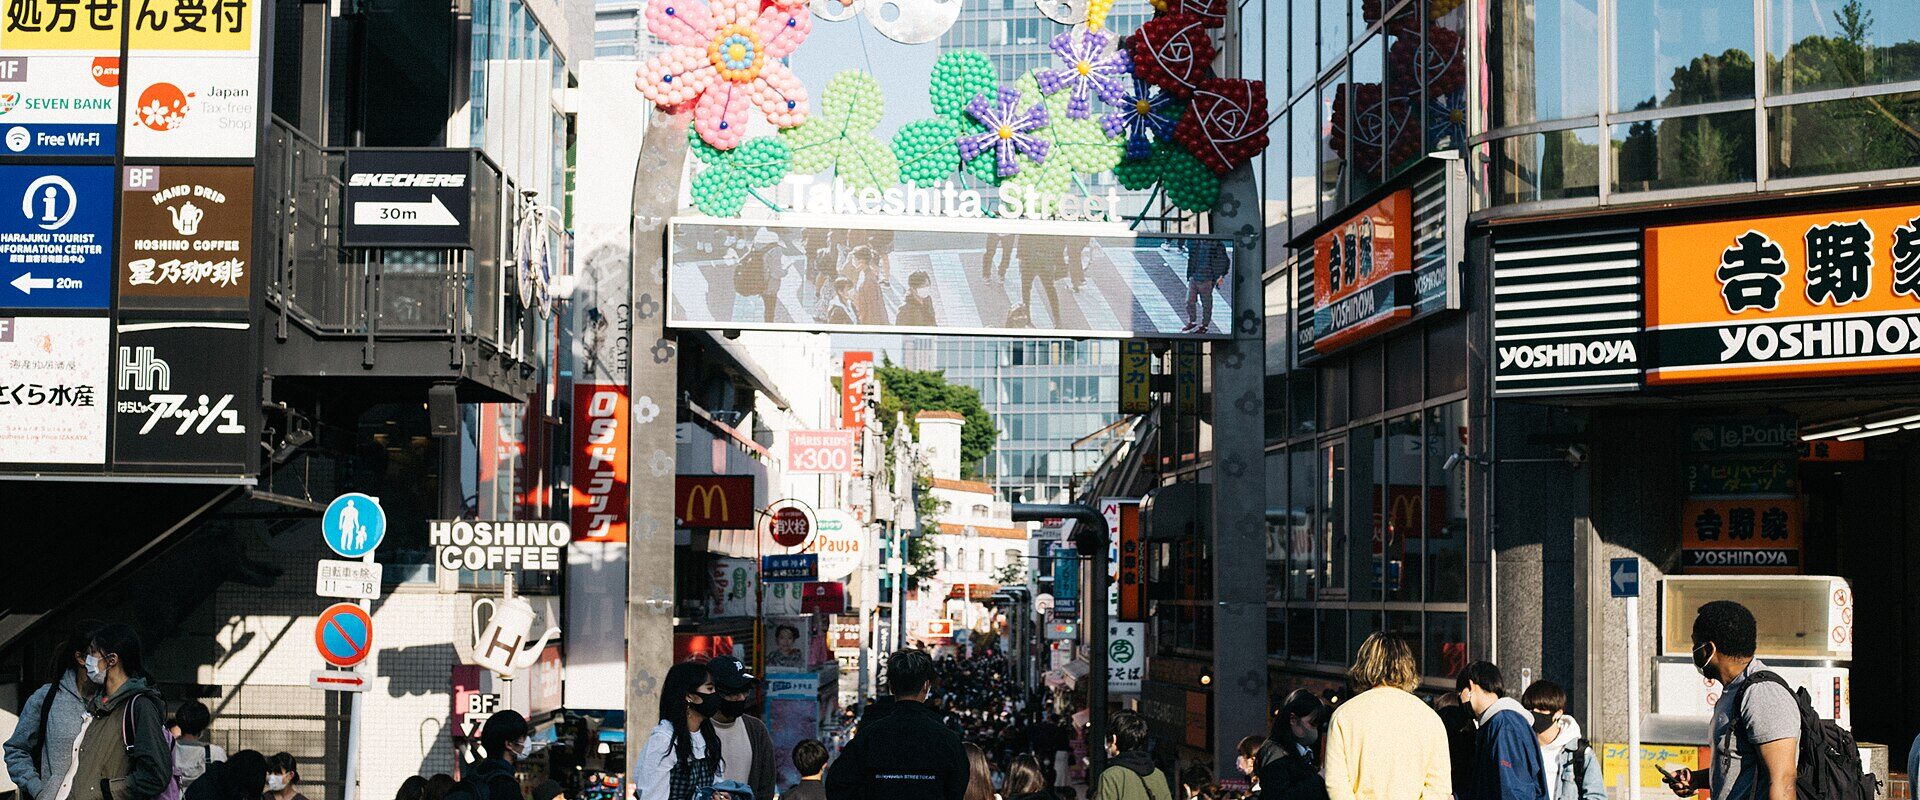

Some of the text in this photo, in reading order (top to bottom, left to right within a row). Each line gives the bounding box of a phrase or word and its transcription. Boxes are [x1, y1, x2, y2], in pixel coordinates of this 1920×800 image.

[207, 86, 249, 98] Japan
[25, 98, 112, 110] SEVEN BANK
[200, 101, 252, 113] Tax-free
[219, 117, 251, 130] Shop
[37, 132, 100, 146] Free Wi-Fi
[129, 168, 153, 188] BF
[348, 173, 466, 187] SKECHERS
[152, 185, 226, 205] HAND DRIP
[783, 173, 1123, 222] Takeshita Street
[380, 207, 417, 219] 30m
[1, 233, 95, 243] HARAJUKU TOURIST
[134, 239, 240, 251] HOSHINO COFFEE
[64, 244, 102, 254] CENTER
[56, 277, 82, 289] 20m
[1330, 289, 1375, 331] YOSHINOYA
[616, 303, 629, 373] CAT CAFE
[1500, 339, 1637, 370] YOSHINOYA
[118, 346, 171, 391] Hh
[793, 447, 847, 470] ¥300
[773, 518, 807, 536] 消火栓
[1695, 506, 1789, 540] 吉野家
[430, 521, 571, 547] HOSHINO
[819, 534, 859, 553] Pausa
[441, 545, 559, 570] COFFEE
[1694, 551, 1788, 565] YOSHINOYA
[325, 580, 336, 592] 11
[362, 582, 373, 594] 18
